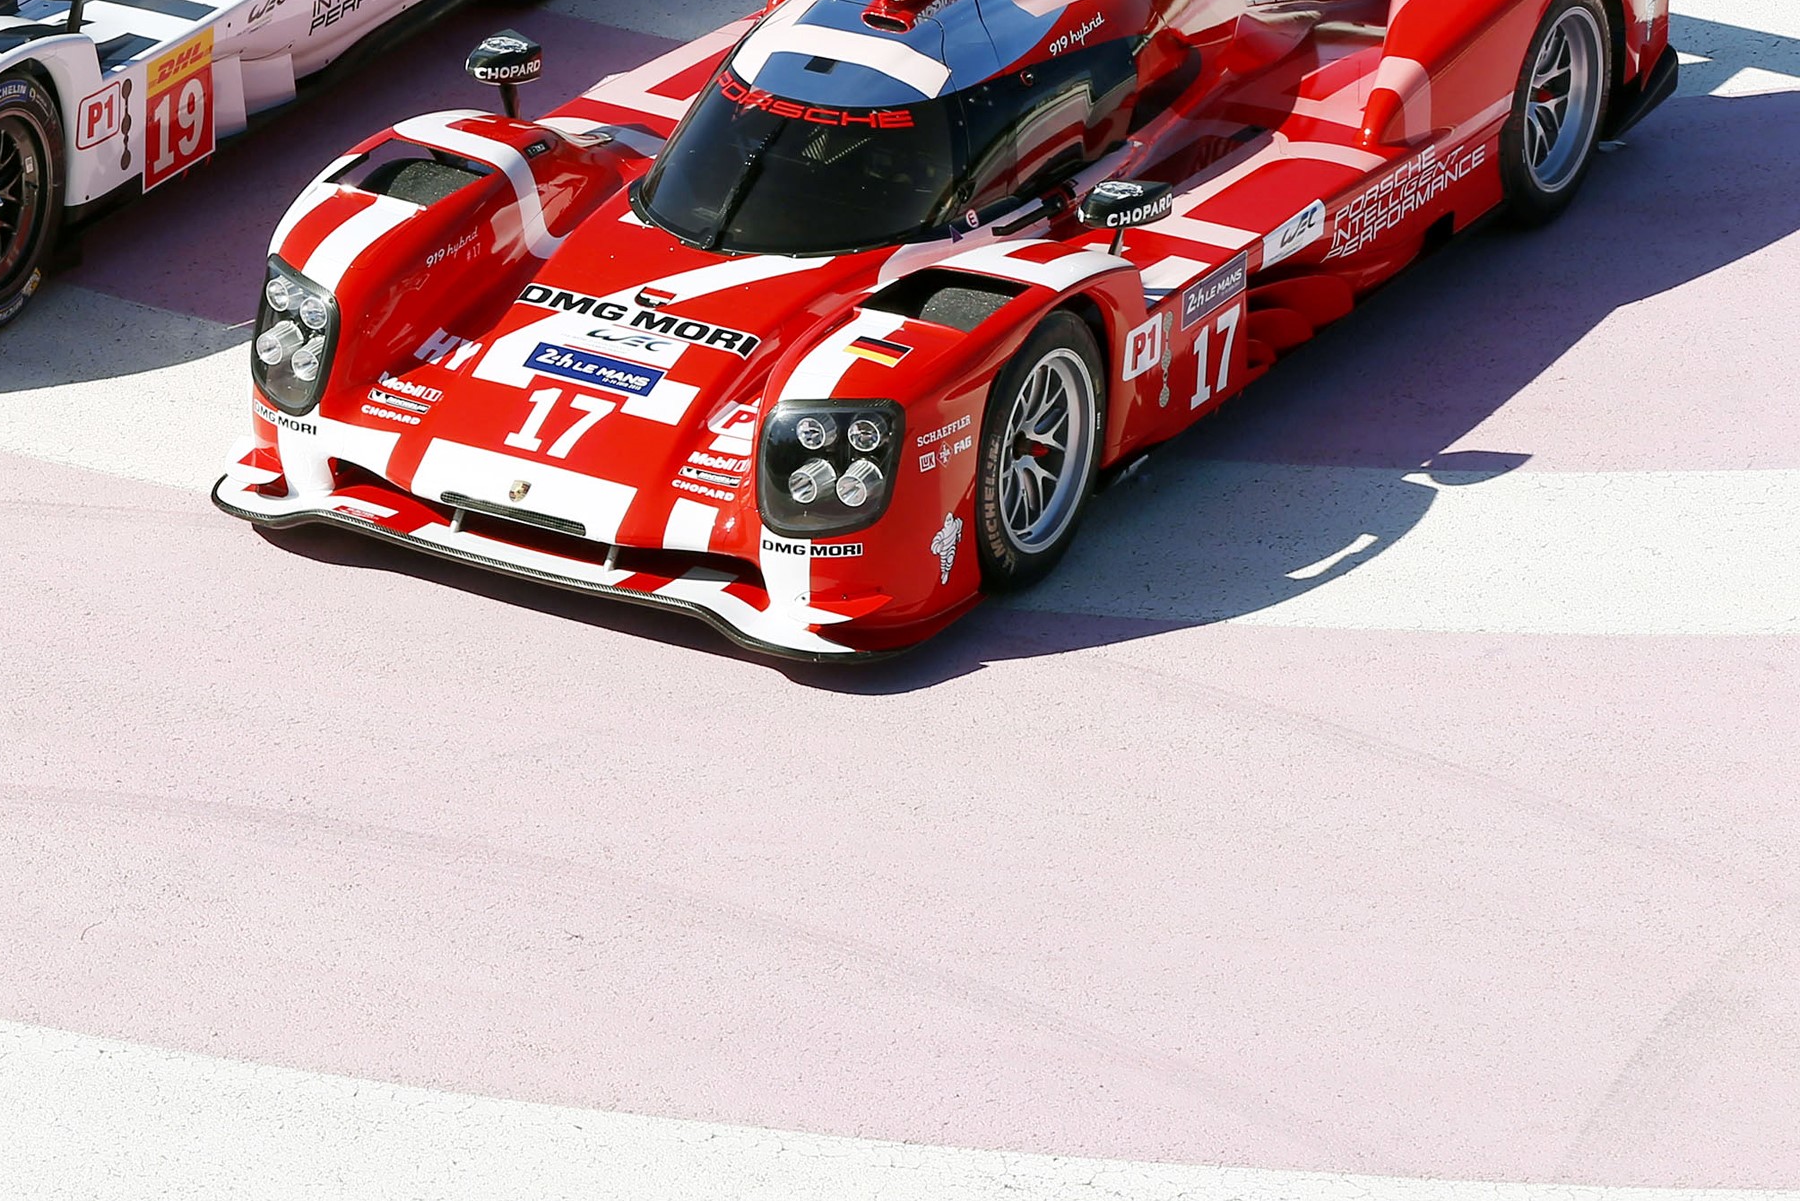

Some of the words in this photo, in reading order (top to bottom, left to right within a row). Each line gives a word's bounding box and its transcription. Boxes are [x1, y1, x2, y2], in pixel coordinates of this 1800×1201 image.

[1047, 33, 1068, 57] 919
[1069, 12, 1106, 49] hybrid
[157, 42, 206, 84] DHL
[473, 59, 541, 80] CHOPARD
[87, 94, 114, 139] P1
[715, 70, 915, 129] PORSCHE
[153, 78, 205, 175] 19
[1319, 144, 1486, 264] PERFORMANCE
[1330, 145, 1465, 249] INTELLIGENT
[1333, 143, 1436, 230] PORSCHE
[1106, 192, 1172, 227] CHOPARD
[426, 248, 446, 268] 919
[446, 226, 479, 260] hybrid
[1205, 285, 1217, 302] LE
[1216, 268, 1243, 297] MANS
[517, 285, 628, 321] DMG
[630, 310, 760, 357] MORI
[413, 327, 484, 371] HY
[1132, 328, 1154, 372] P1
[1190, 303, 1241, 411] 17
[378, 371, 427, 398] Mobil
[571, 358, 599, 374] LE
[595, 366, 651, 387] MANS
[278, 415, 317, 436] MORI
[360, 404, 422, 426] CHOPARD
[503, 387, 617, 460] 17
[916, 414, 971, 448] SCHAEFFLER
[687, 450, 738, 471] Mobil
[953, 435, 973, 456] FAG
[671, 479, 736, 502] CHOPARD
[762, 539, 806, 556] DMG
[809, 543, 863, 557] MORI
